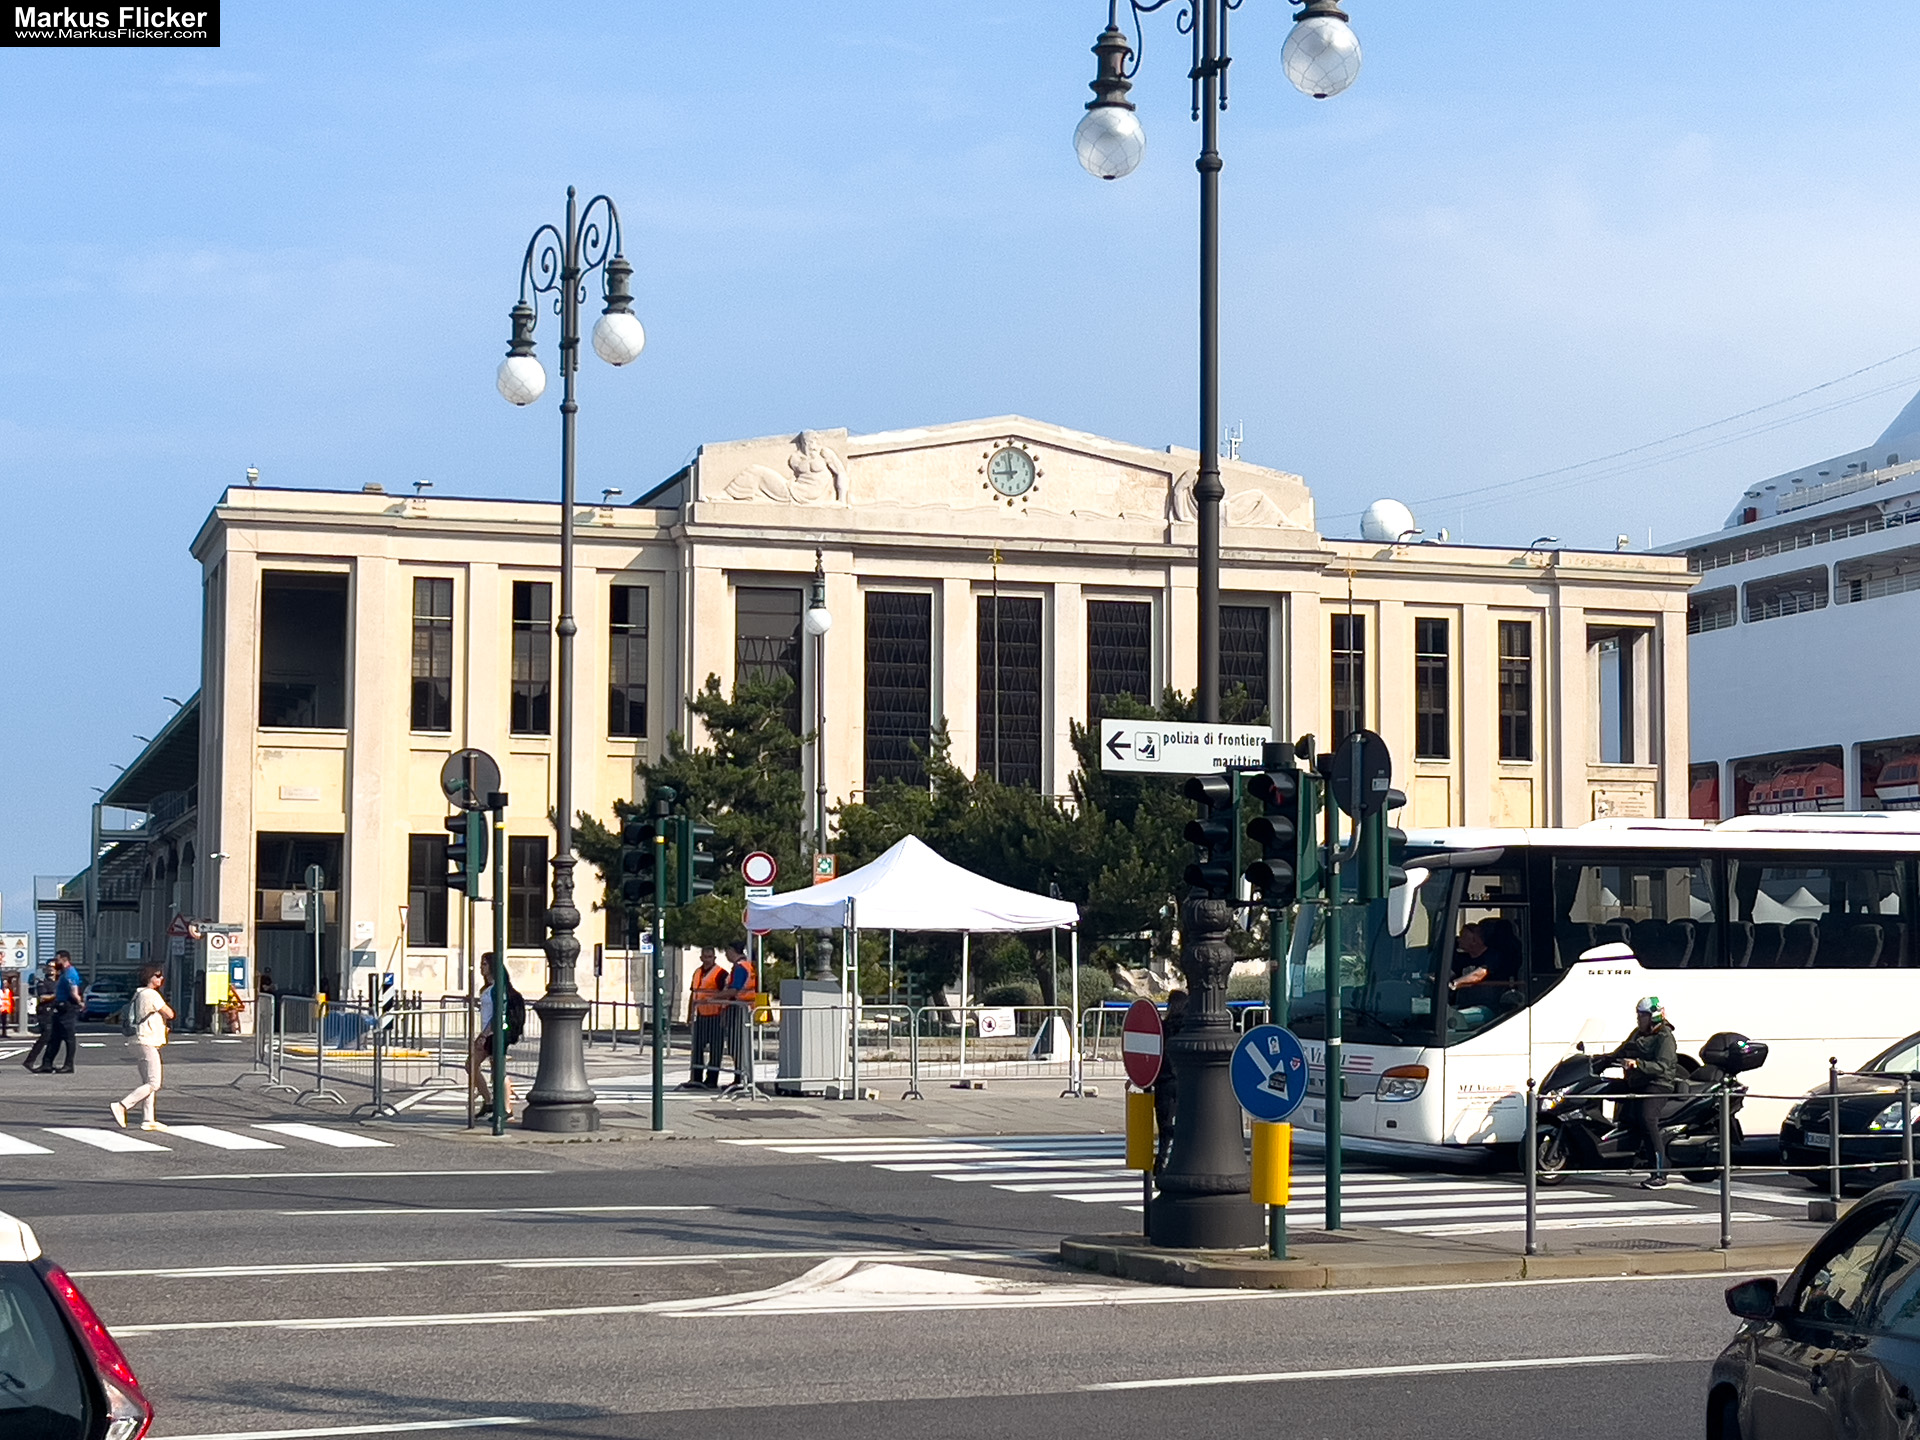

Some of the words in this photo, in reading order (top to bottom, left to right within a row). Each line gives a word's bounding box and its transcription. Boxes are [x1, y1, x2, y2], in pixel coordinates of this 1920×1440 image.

[1163, 731, 1199, 746] polizia
[1204, 732, 1213, 745] di
[1218, 732, 1267, 747] frontiera
[1213, 755, 1262, 767] marittim
